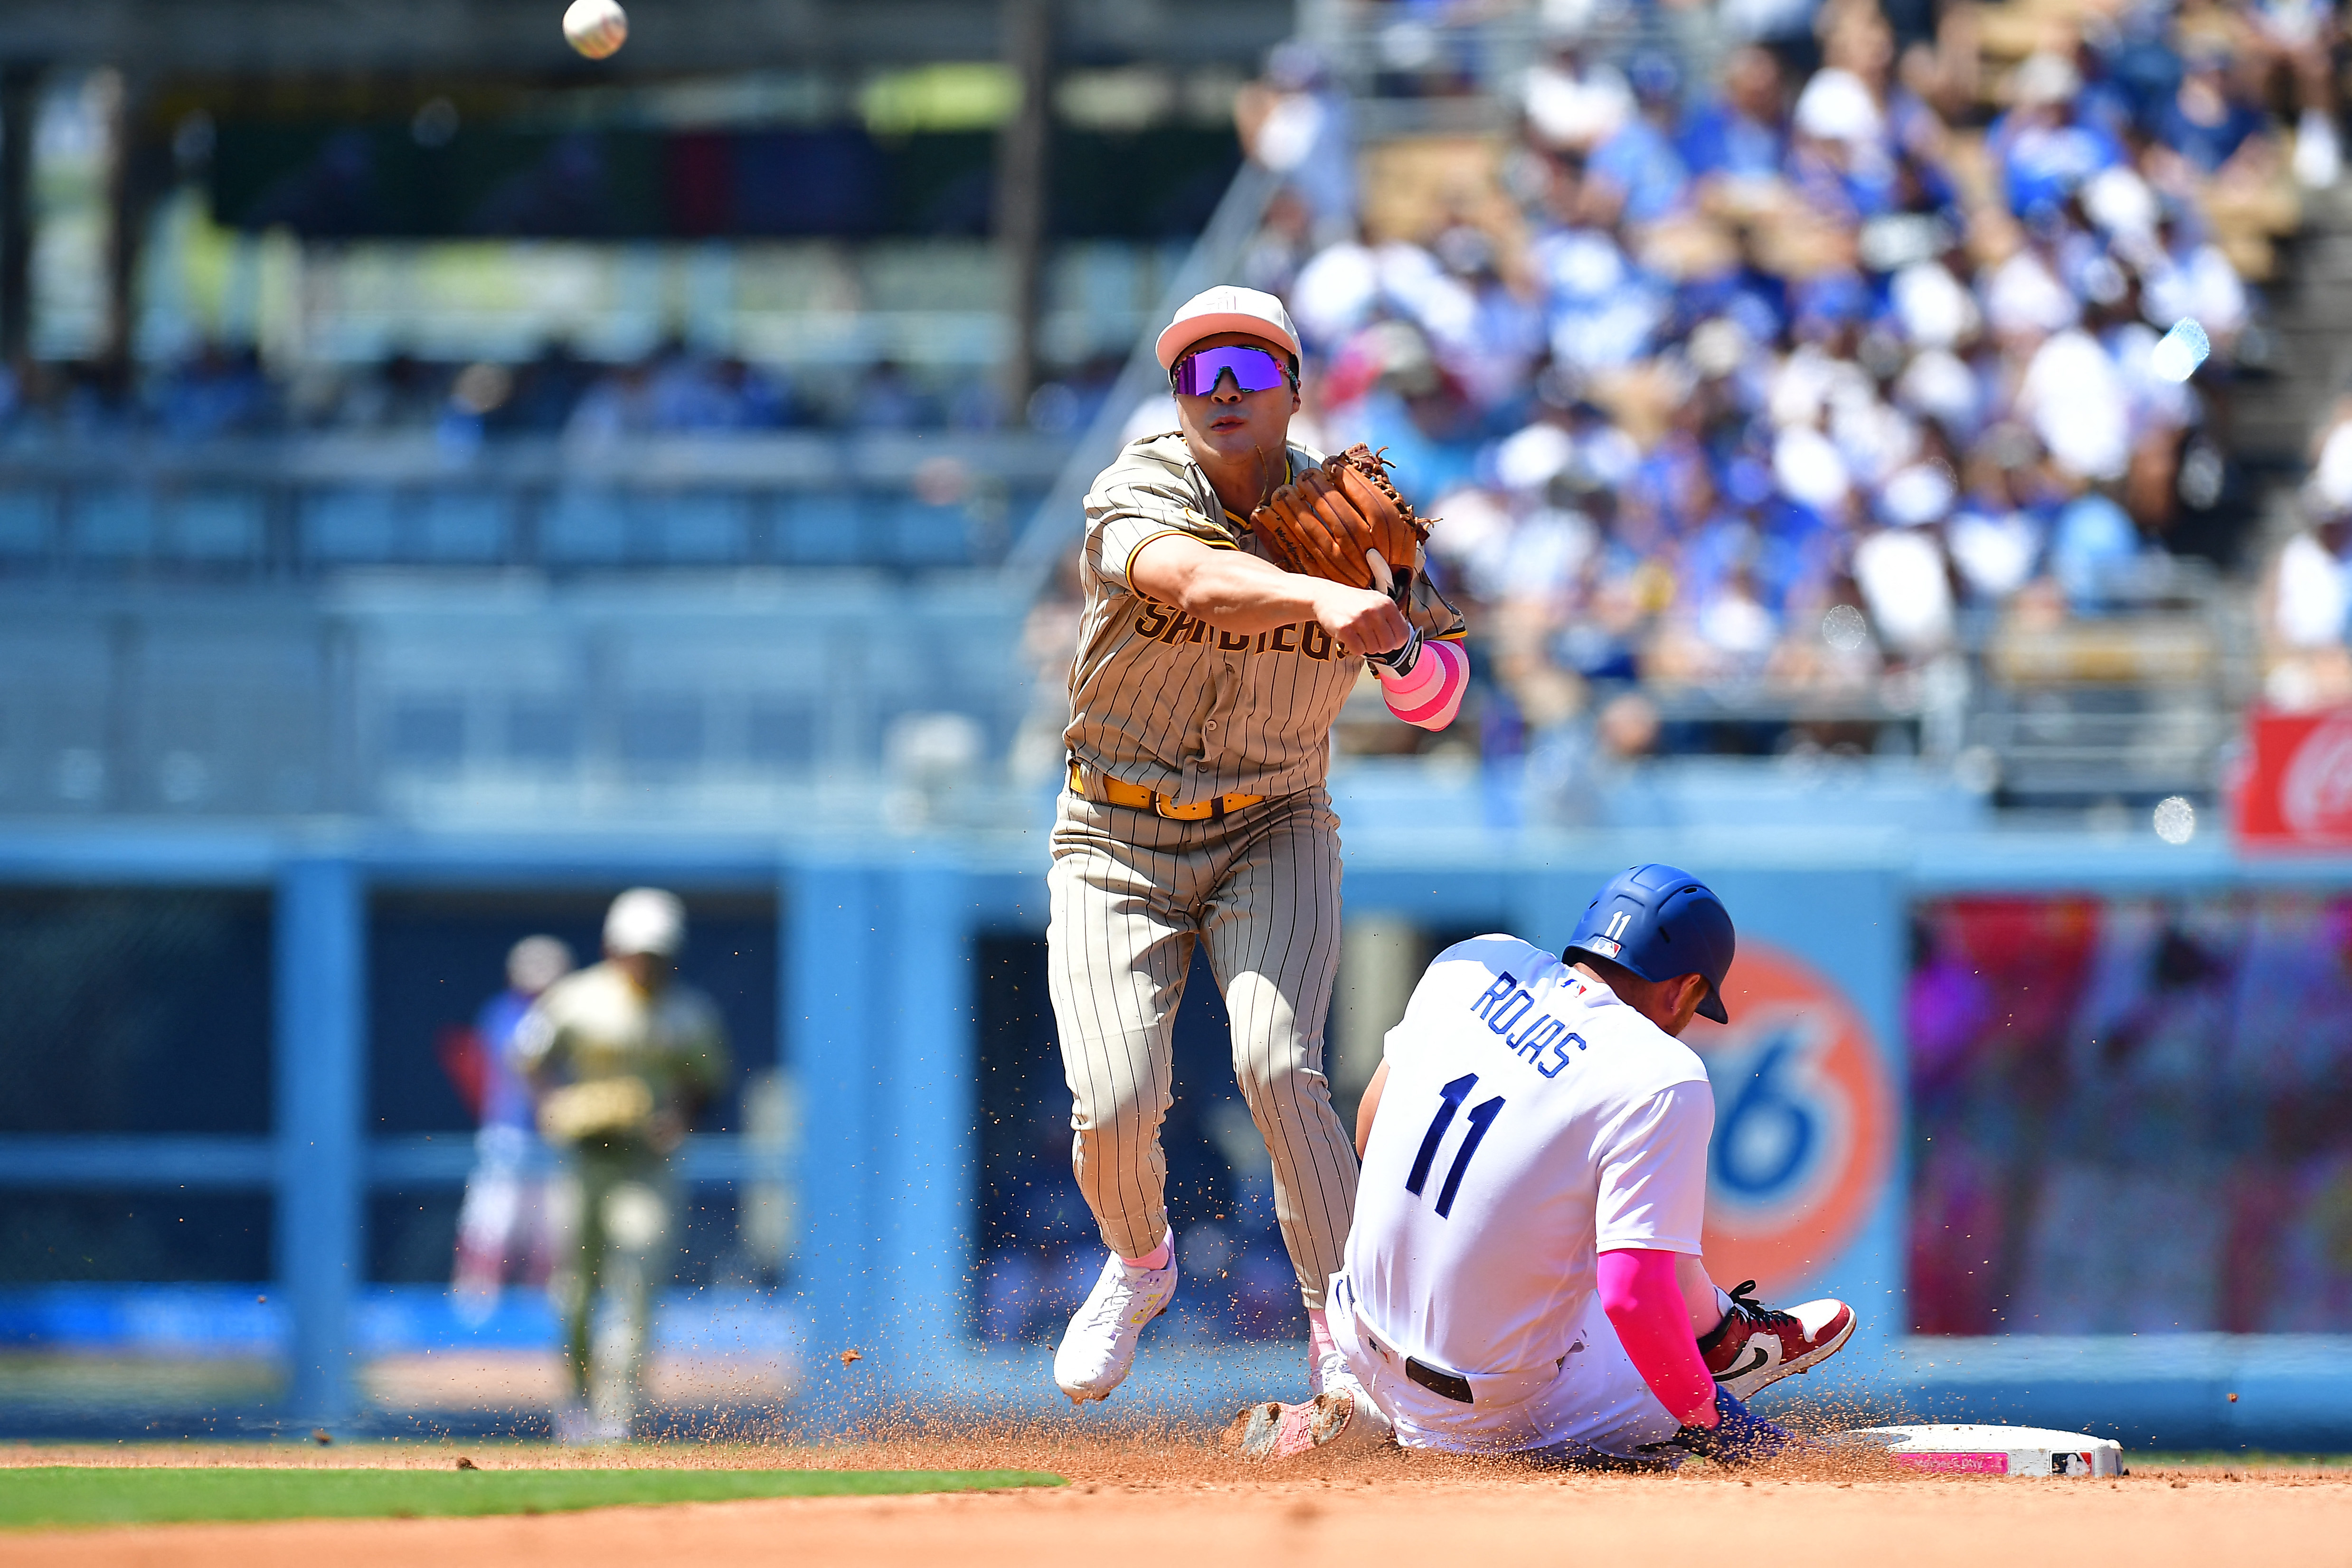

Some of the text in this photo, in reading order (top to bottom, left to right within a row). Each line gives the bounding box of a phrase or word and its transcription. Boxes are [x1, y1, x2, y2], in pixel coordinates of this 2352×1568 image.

[1216, 619, 1350, 661] DIEG
[1604, 910, 1632, 941] 11
[1470, 970, 1587, 1078] ROJAS
[1406, 1073, 1506, 1220] 11
